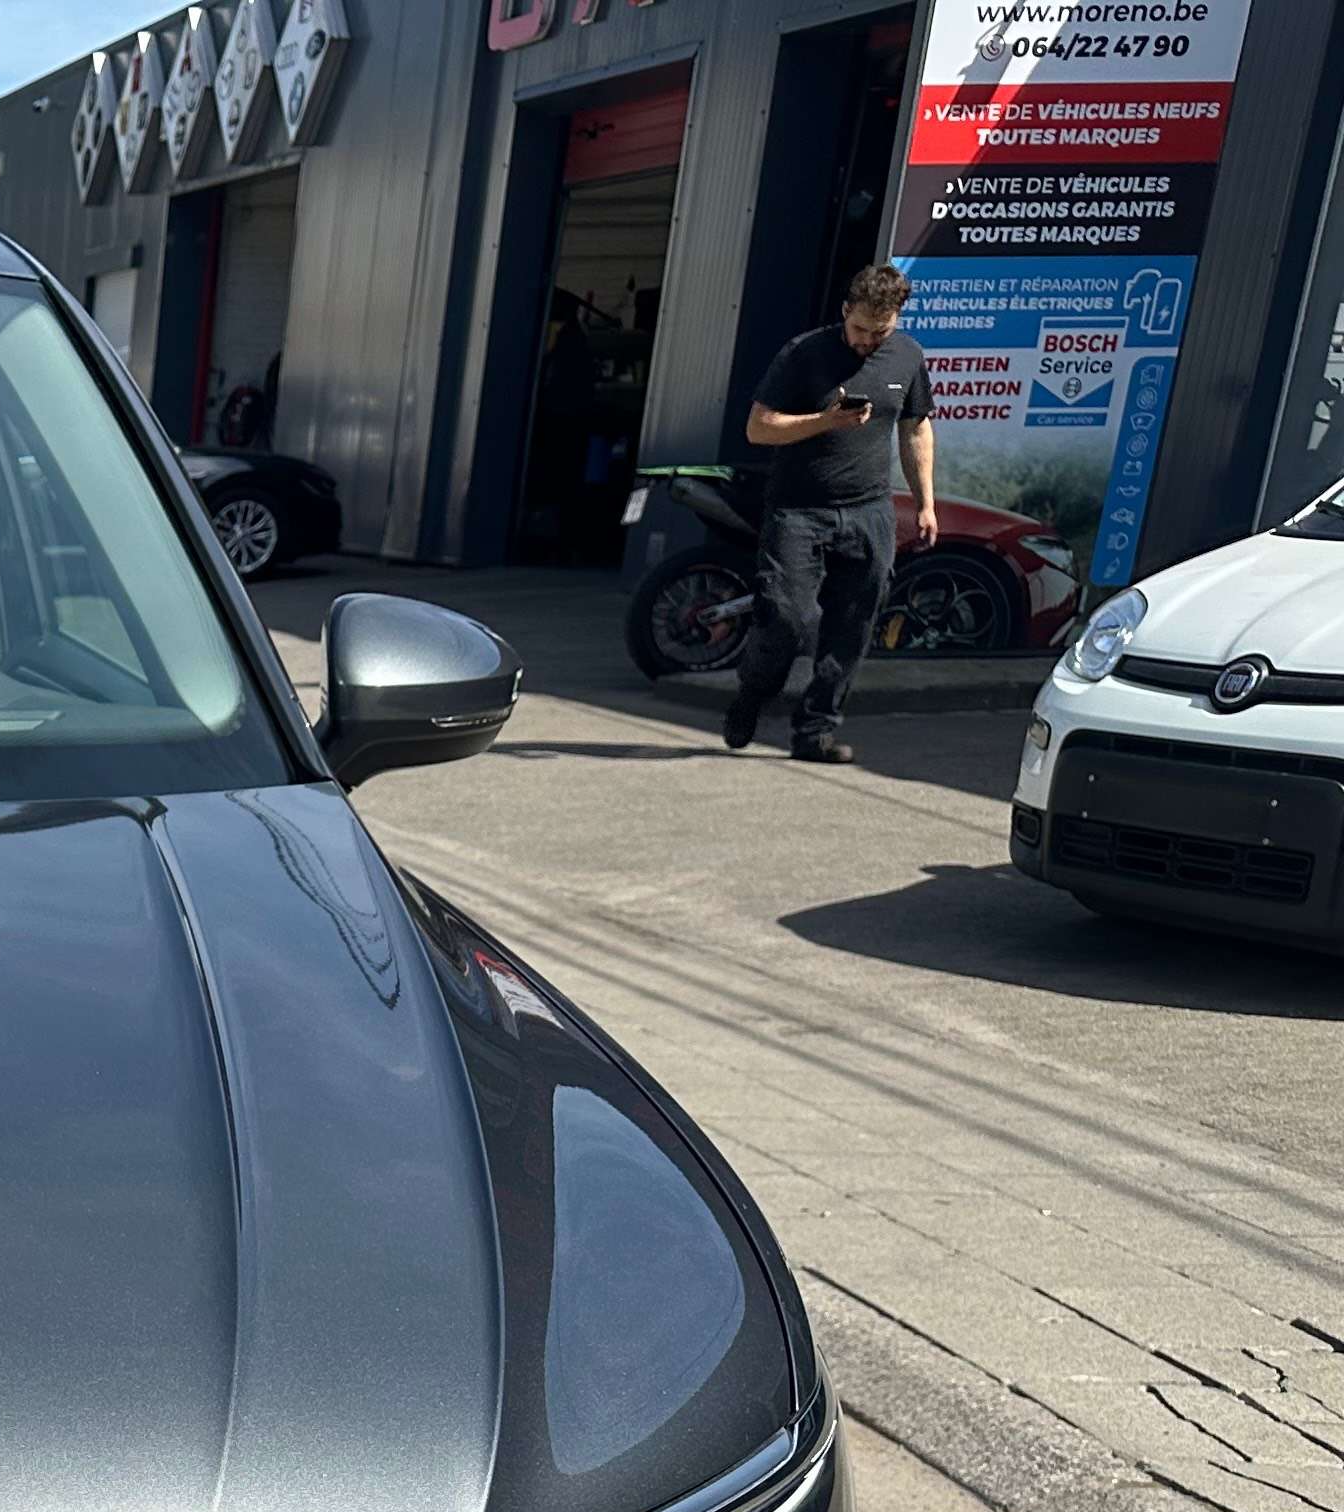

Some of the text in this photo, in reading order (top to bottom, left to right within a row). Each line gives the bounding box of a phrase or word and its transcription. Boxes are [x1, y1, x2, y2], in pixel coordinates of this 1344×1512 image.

[977, 0, 1208, 22] www.moreno.be
[1012, 35, 1190, 60] 064/22 47 90
[936, 99, 1220, 121] VENTE DE VÉHICULES NEUFS
[976, 128, 1160, 147] TOUTES MARQUES
[957, 173, 1170, 194] VENTE DE VÉHICULES
[932, 201, 1175, 219] D'OCCASIONS GARANTIS
[959, 226, 1140, 245] TOUTES MARQUES
[912, 275, 1119, 293] ENTRETIEN ET RÉPARATION
[922, 294, 1011, 310] VÉHICULES
[1009, 294, 1114, 312] ÉLECTRIQUES
[1044, 334, 1118, 353] BOSCH
[925, 357, 1010, 372] TRETIEN
[1039, 356, 1113, 374] Service
[931, 381, 1022, 395] ARATION
